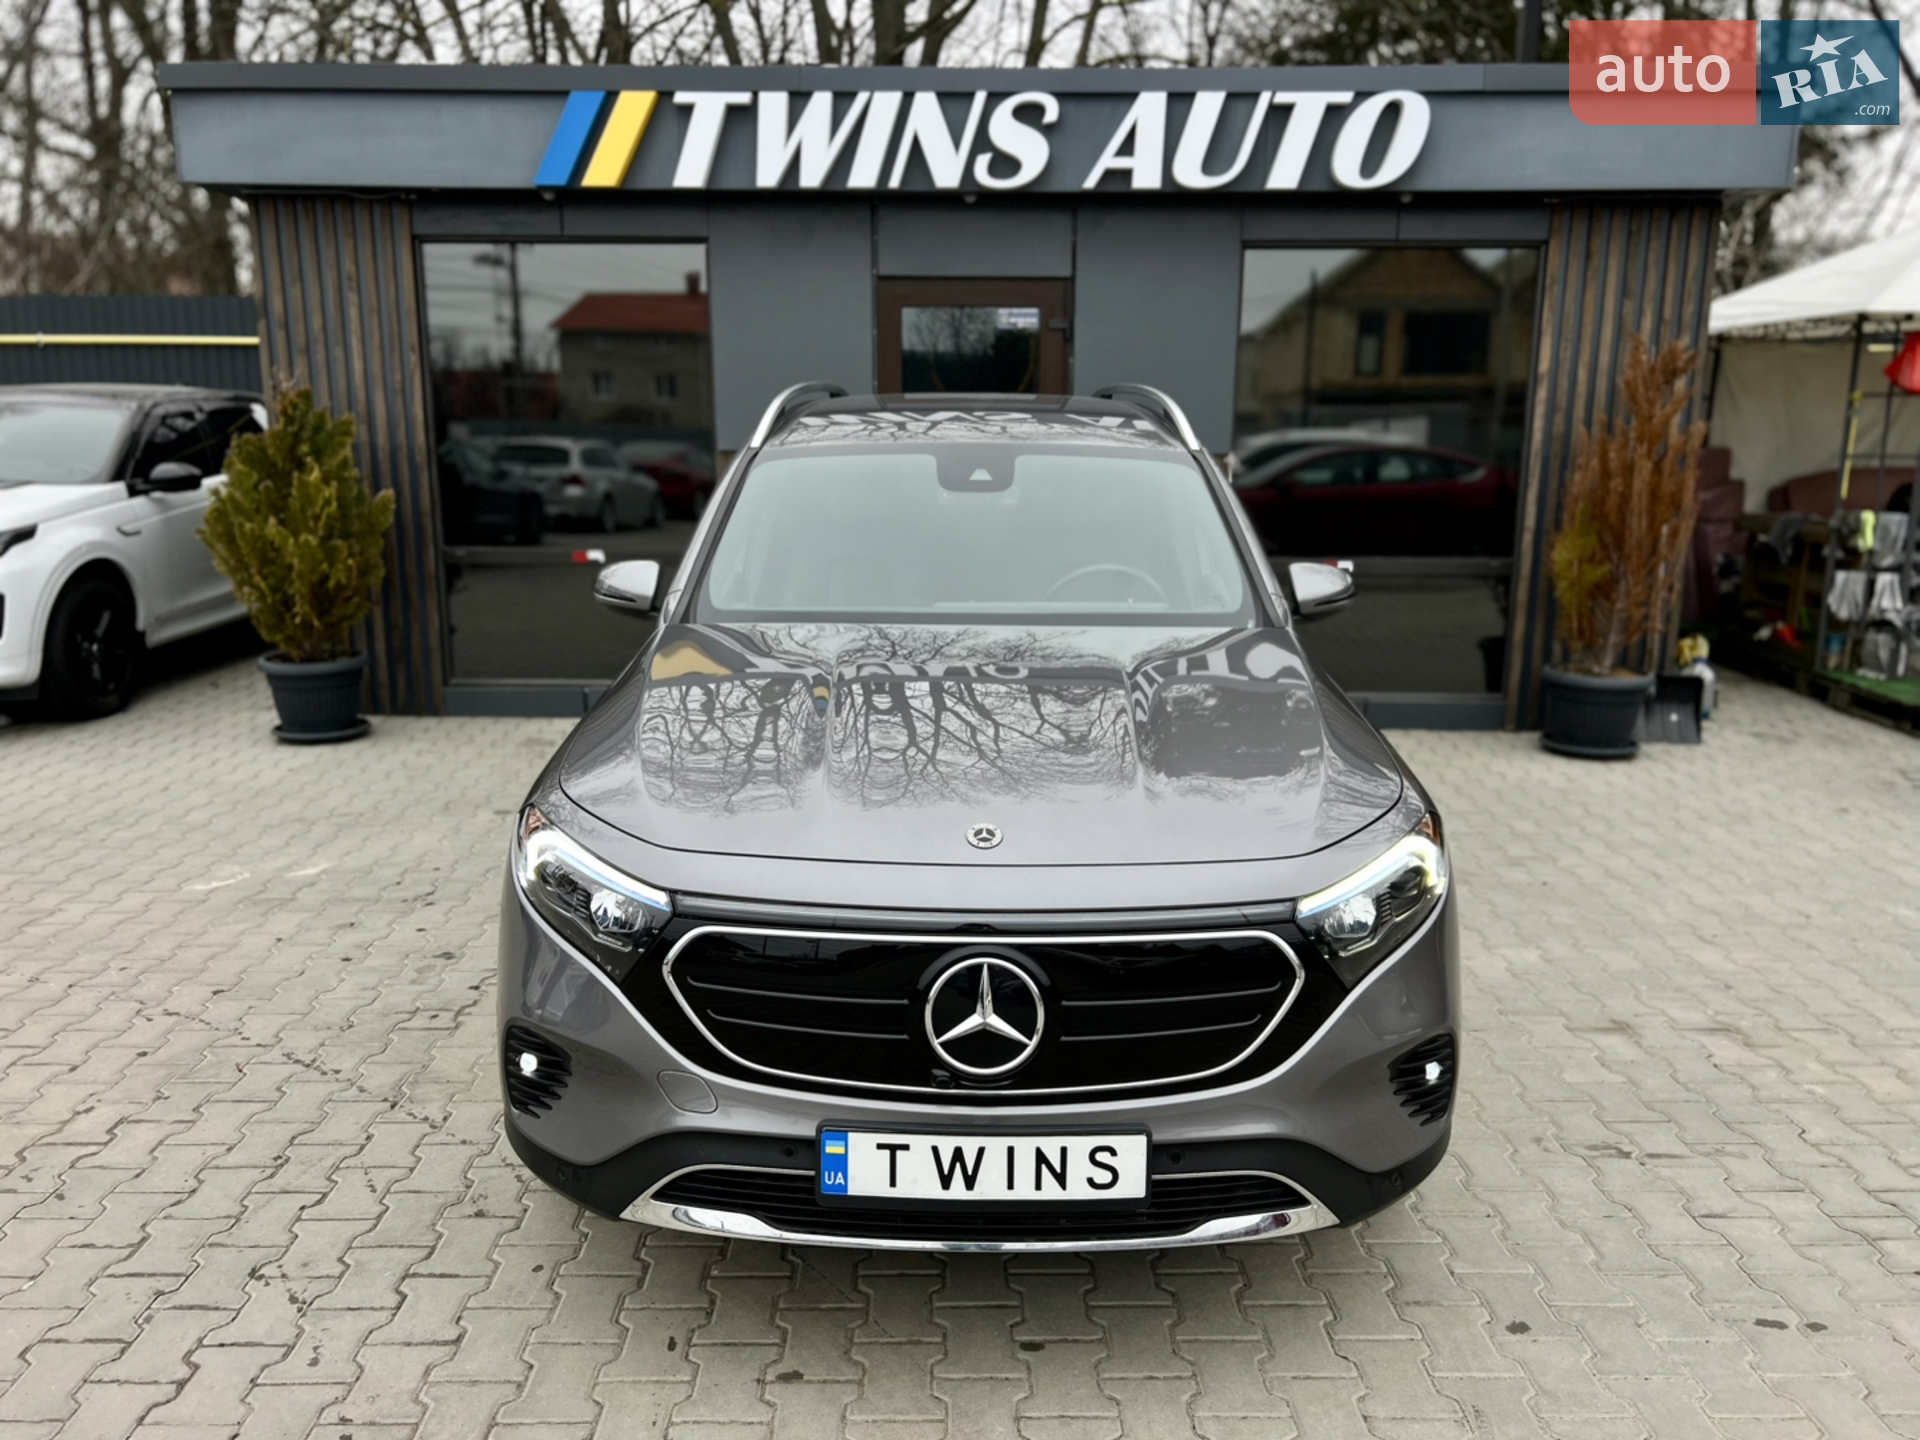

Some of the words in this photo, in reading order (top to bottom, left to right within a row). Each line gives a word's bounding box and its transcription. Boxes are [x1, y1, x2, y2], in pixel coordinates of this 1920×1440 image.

[672, 91, 1060, 190] TWINS
[1081, 90, 1431, 190] AUTO
[825, 1172, 845, 1185] UA
[876, 1143, 1119, 1191] TWINS
